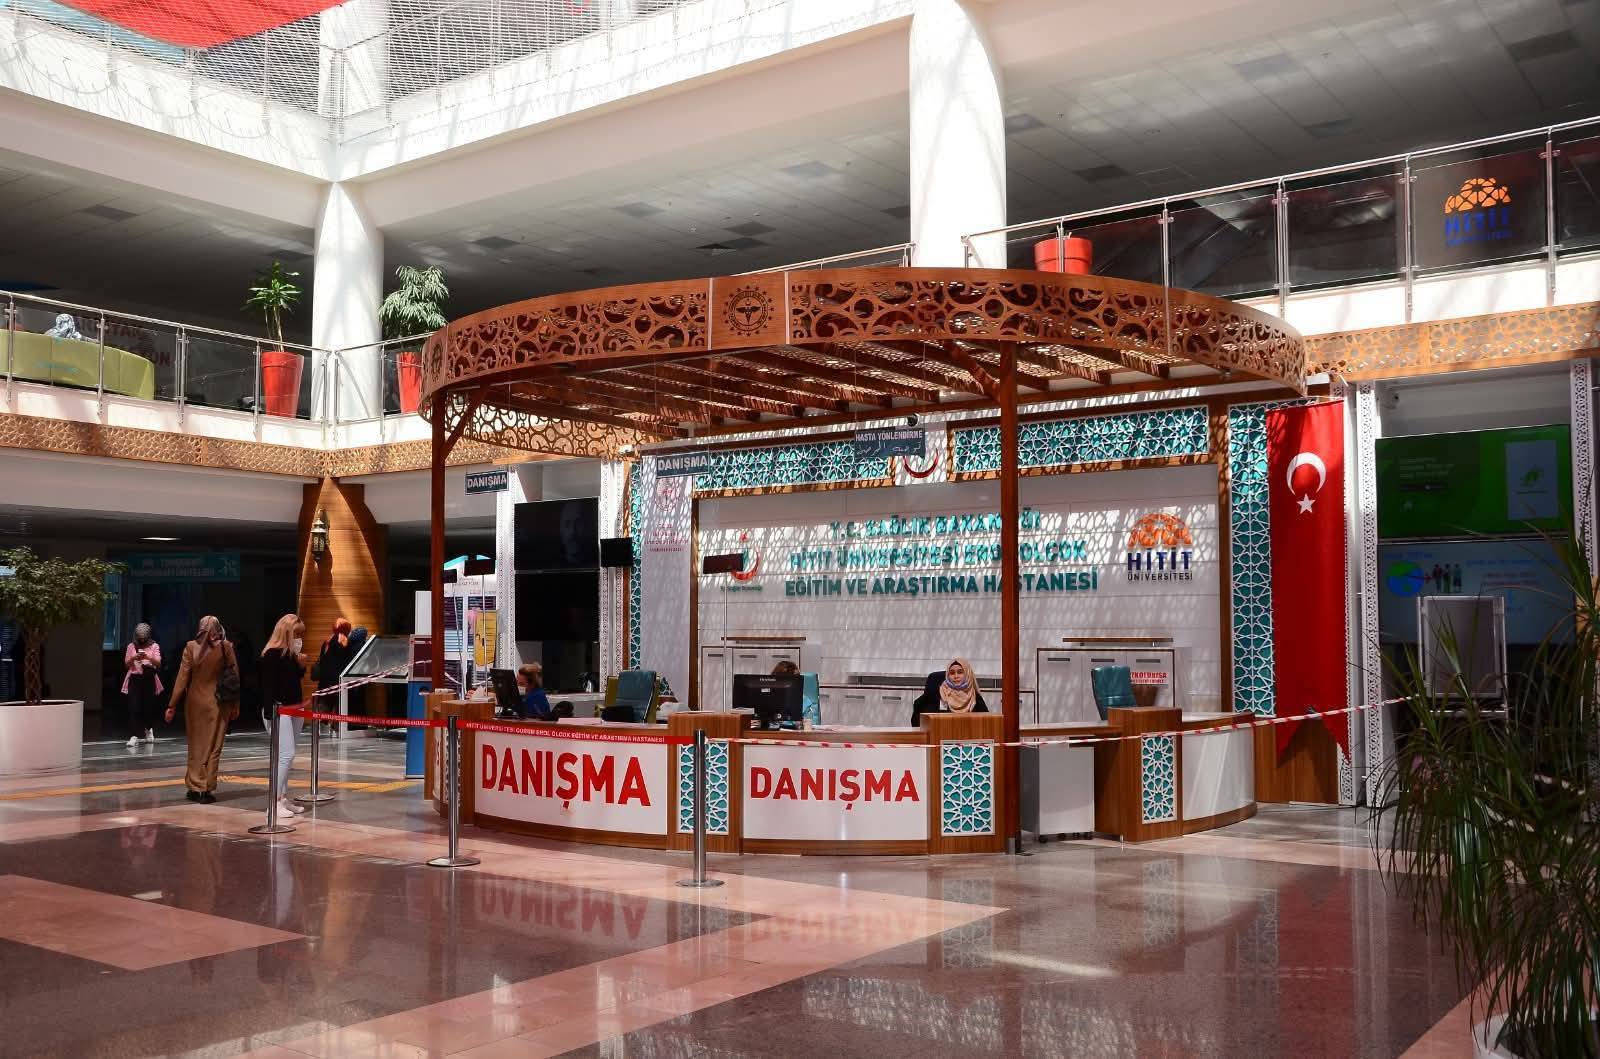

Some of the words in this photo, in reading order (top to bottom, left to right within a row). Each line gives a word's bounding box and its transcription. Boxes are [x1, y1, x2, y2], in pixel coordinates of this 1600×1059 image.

[855, 432, 876, 442] HASTA
[877, 430, 923, 441] YÖNLENDİRME
[658, 455, 707, 472] DANIŞMA
[467, 473, 507, 489] DANIŞMA
[866, 514, 931, 538] SAĞLIK
[935, 507, 1040, 536] BAKANĞI
[790, 546, 834, 570] HİTİT
[838, 540, 959, 570] ÜNİVERSİTESİ
[963, 543, 1008, 567] ERO
[1128, 547, 1193, 571] HİTİT
[785, 574, 842, 597] EĞİTİM
[845, 578, 868, 595] VE
[871, 576, 979, 597] ARAŞTIRMA
[983, 565, 1098, 593] HTANESİ
[1128, 571, 1193, 582] ÜNİVERSİTESİ
[481, 743, 651, 810] DANIŞMA
[750, 766, 920, 810] DANIŞMA
